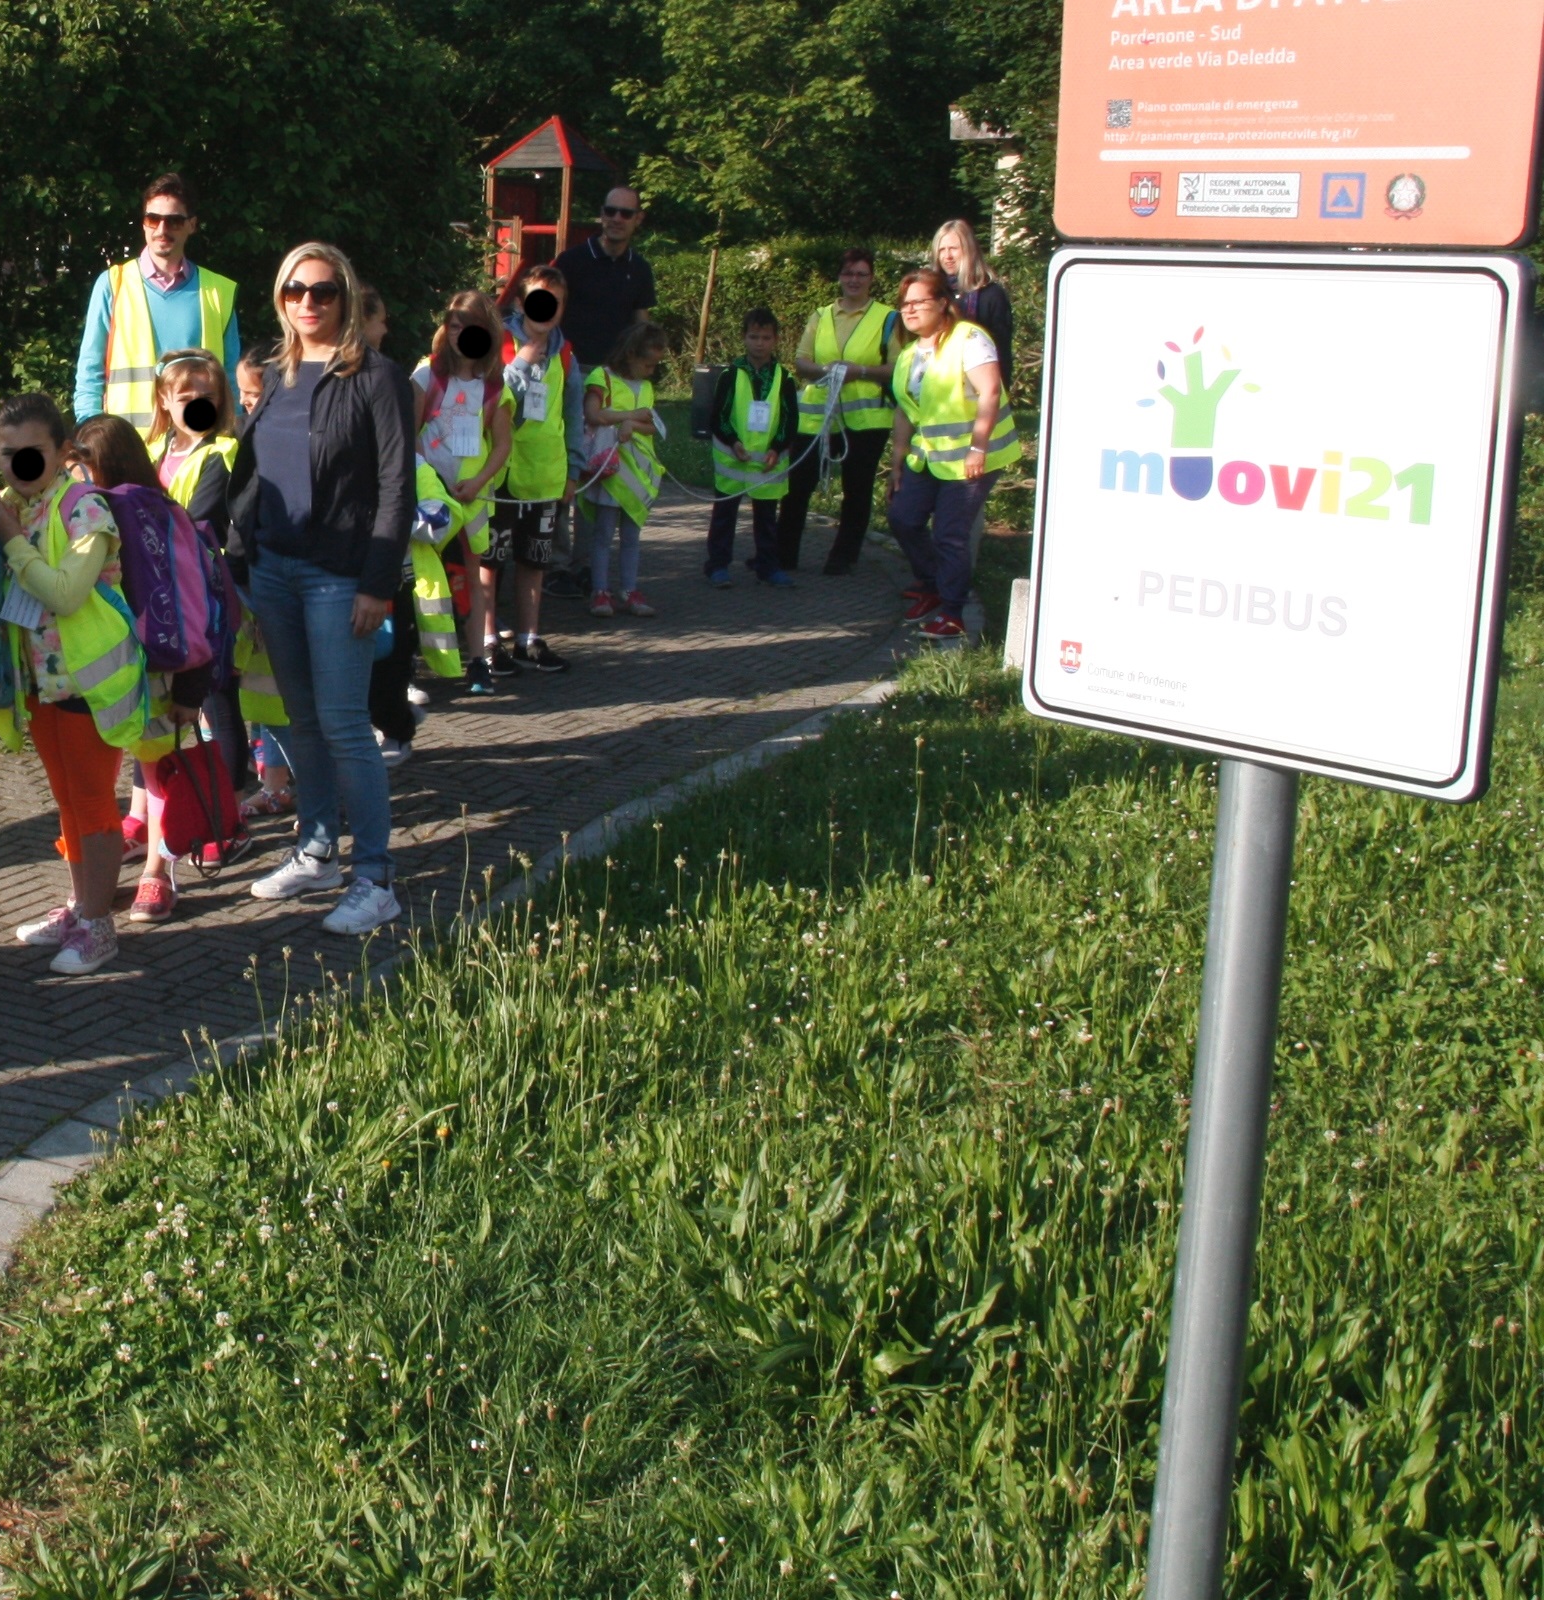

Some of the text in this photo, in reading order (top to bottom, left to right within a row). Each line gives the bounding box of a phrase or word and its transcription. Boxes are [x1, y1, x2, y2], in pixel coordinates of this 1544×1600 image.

[1110, 28, 1195, 46] Pordenone
[1210, 24, 1242, 41] Sud
[1108, 47, 1296, 71] Area verde Via Deledda
[1137, 98, 1298, 113] Piano comunale di emergenza
[1181, 203, 1220, 213] Protezione
[1241, 204, 1259, 213] della
[1260, 204, 1291, 216] Regione
[1138, 570, 1349, 637] PEDIBUS
[1087, 662, 1188, 692] Comune di Pordenone
